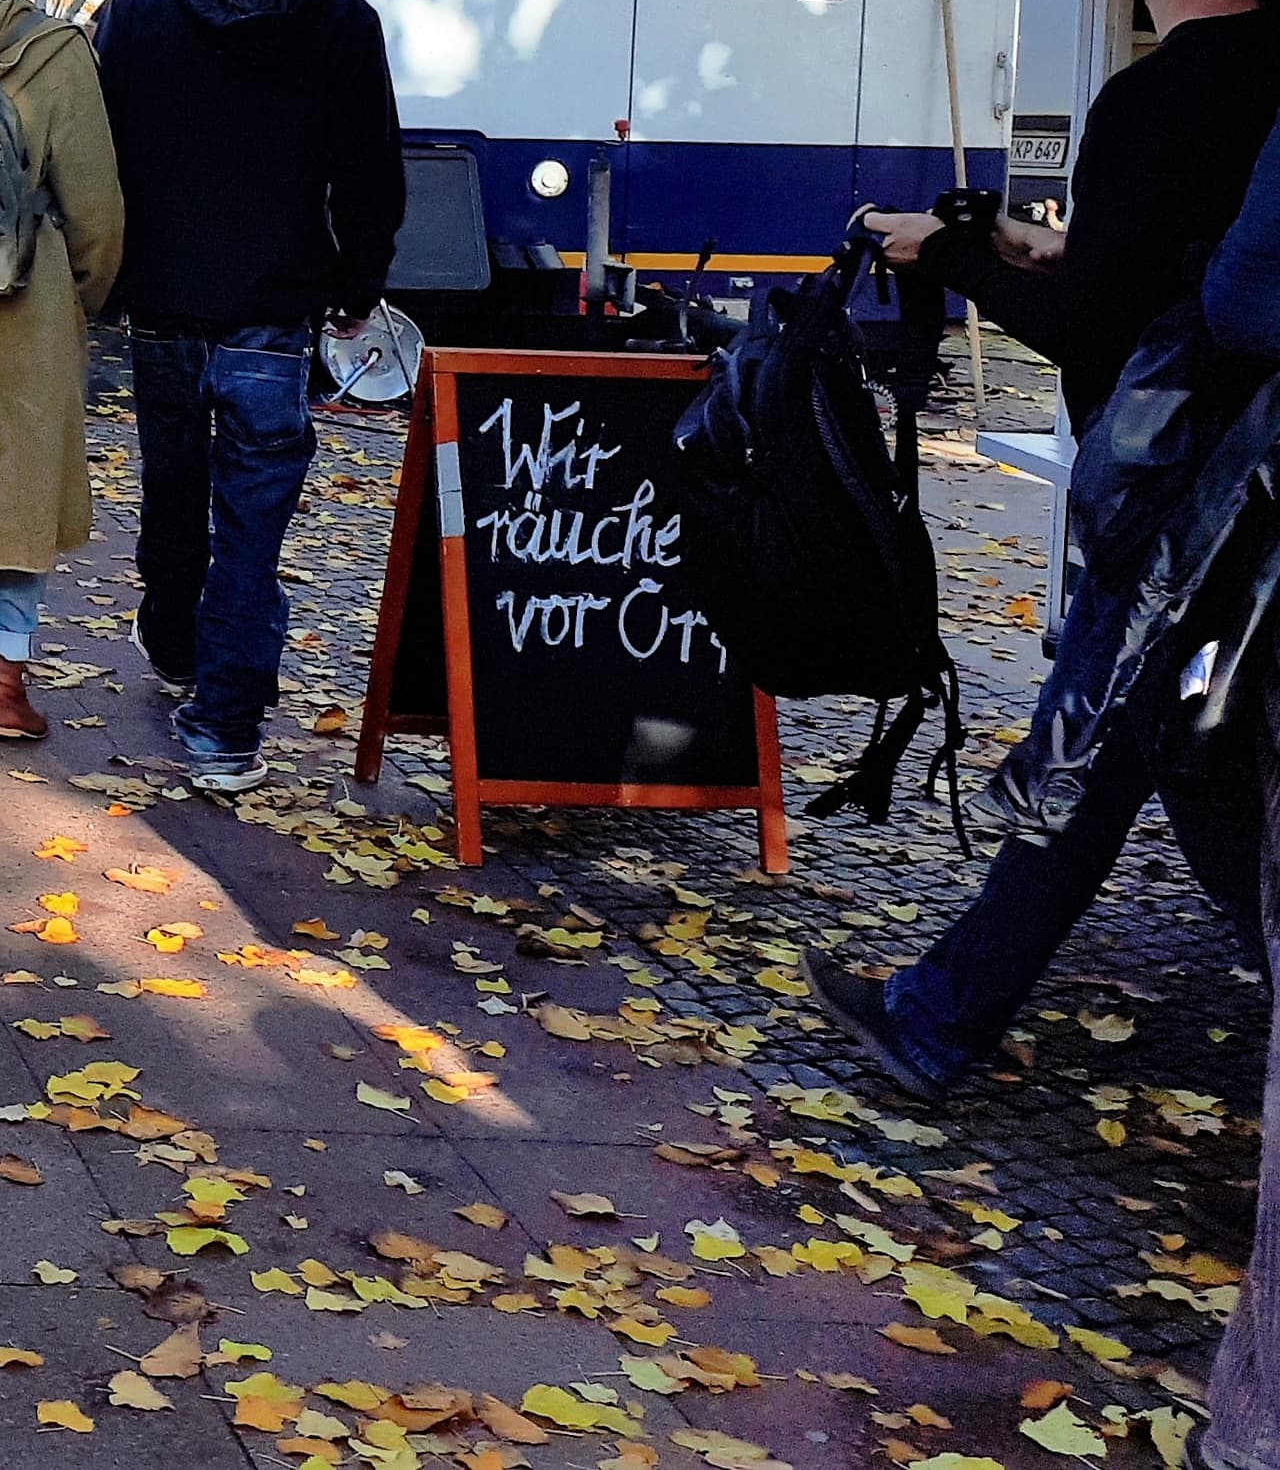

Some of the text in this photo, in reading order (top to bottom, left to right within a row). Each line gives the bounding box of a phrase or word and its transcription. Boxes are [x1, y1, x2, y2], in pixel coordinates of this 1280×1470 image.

[1011, 140, 1061, 160] KP 649
[479, 398, 622, 490] Wir
[476, 479, 682, 569] räuche
[495, 590, 612, 653] vor
